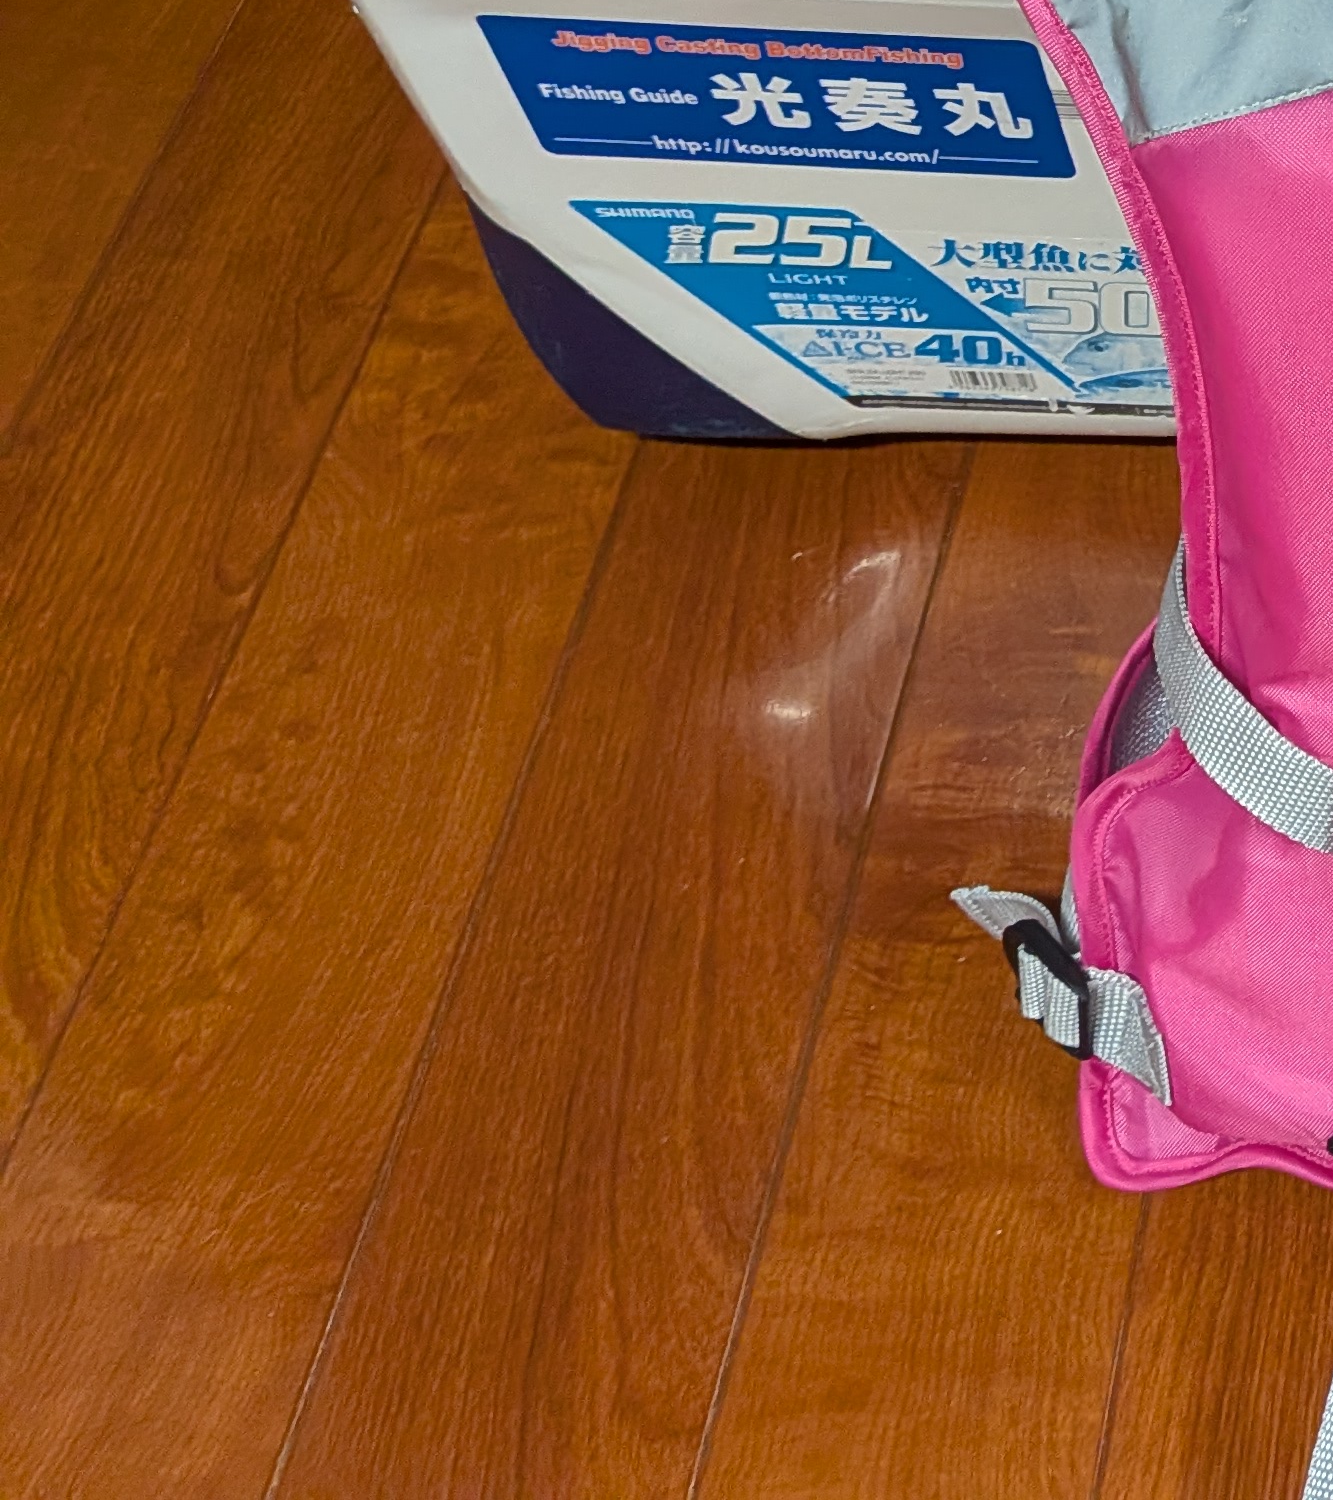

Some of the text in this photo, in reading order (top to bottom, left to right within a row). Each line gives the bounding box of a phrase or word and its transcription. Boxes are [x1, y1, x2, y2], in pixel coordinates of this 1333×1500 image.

[551, 29, 965, 69] Jigging Casting BottomFishing
[537, 82, 700, 106] Fishing Guide
[710, 72, 1034, 140] 光奏丸
[653, 134, 941, 165] http://kousoumaru.com/
[596, 207, 694, 220] SHIMANO
[665, 224, 705, 263] 容量
[709, 213, 893, 270] 25L
[966, 276, 1020, 297] 内寸
[777, 303, 930, 324] 軽量モデル
